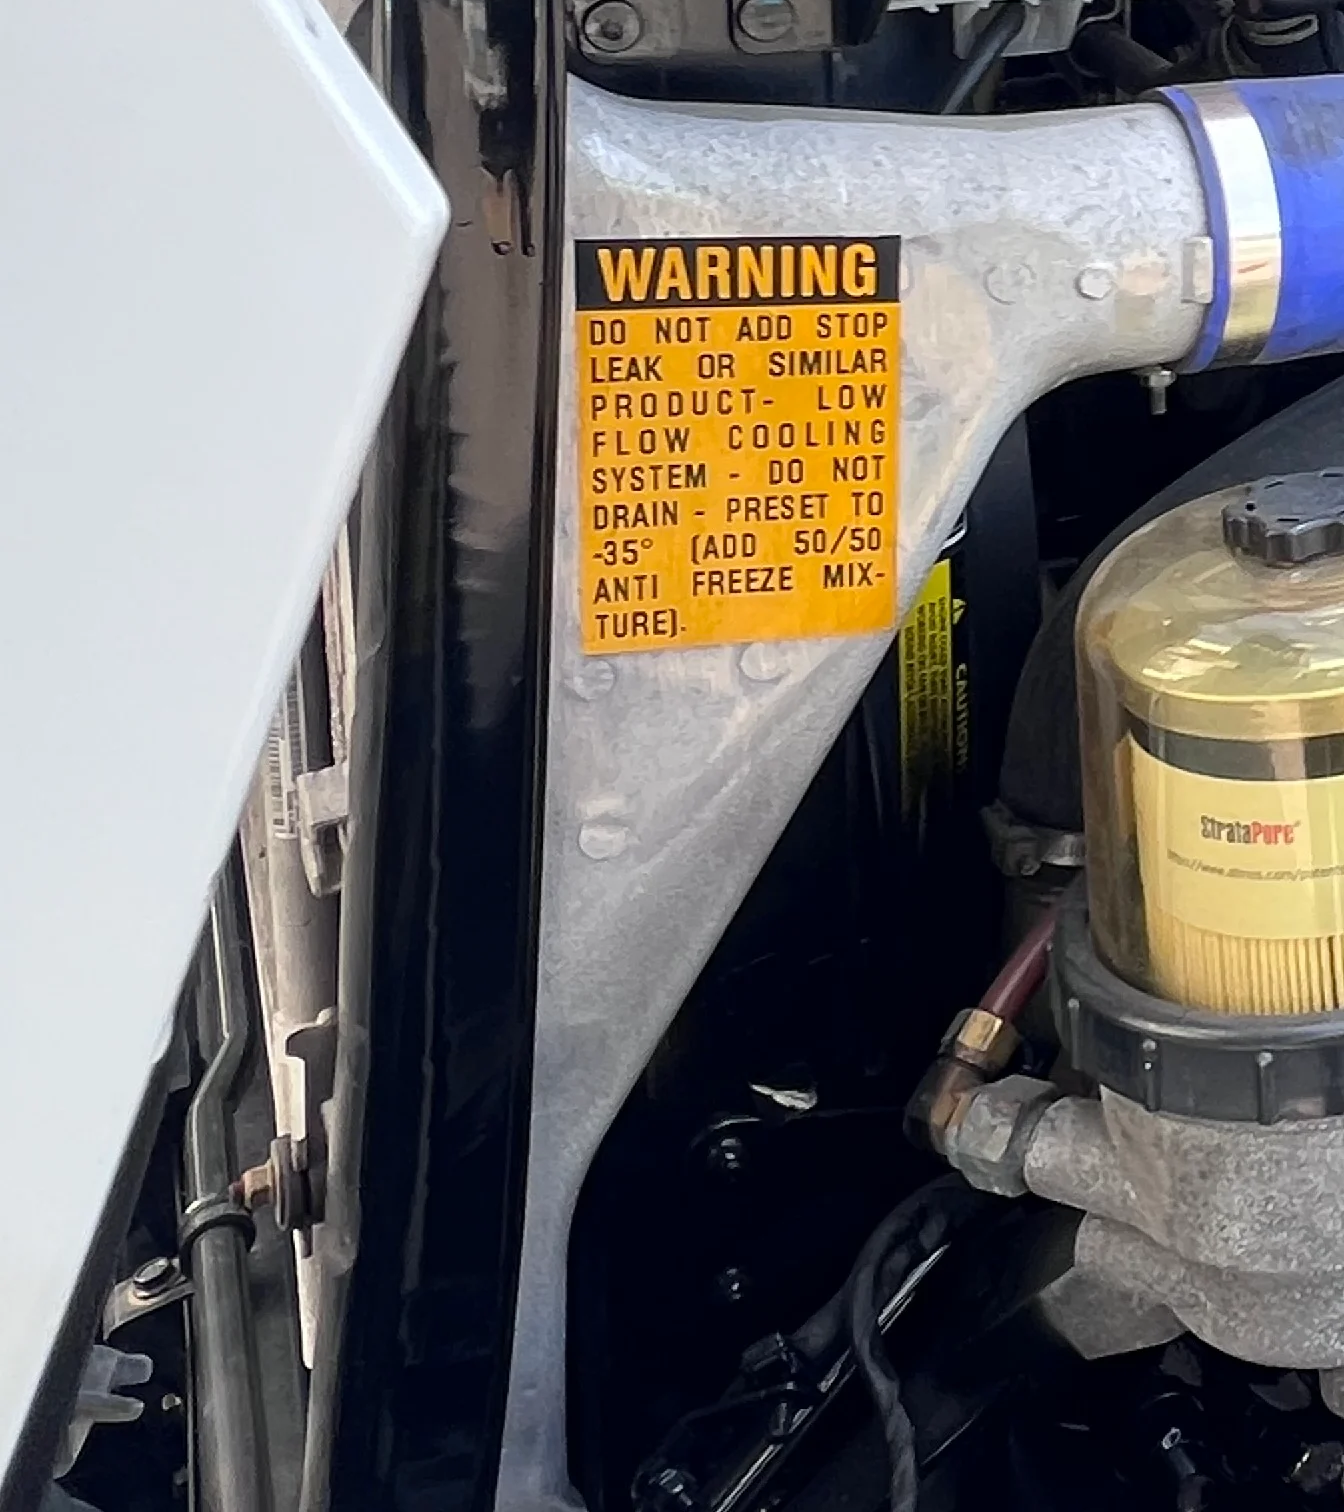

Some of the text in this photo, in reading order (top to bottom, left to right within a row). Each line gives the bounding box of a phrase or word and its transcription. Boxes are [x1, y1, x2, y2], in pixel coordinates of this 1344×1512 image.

[597, 243, 878, 302] WARNING
[590, 312, 889, 346] DO NOT ADD STOP
[590, 348, 887, 384] LEAK OR SIMILAR
[591, 384, 886, 421] PRODUCT- LOW
[592, 419, 885, 458] FLOW COOLING
[592, 463, 707, 494] SYSTEM
[769, 459, 804, 485] DO
[832, 455, 885, 482] NOT
[594, 501, 679, 531] DRAIN
[726, 493, 829, 522] PRESET
[851, 491, 884, 517] TO
[794, 525, 882, 555] 50/50
[593, 562, 885, 605] ANTI FREEZE MIX-
